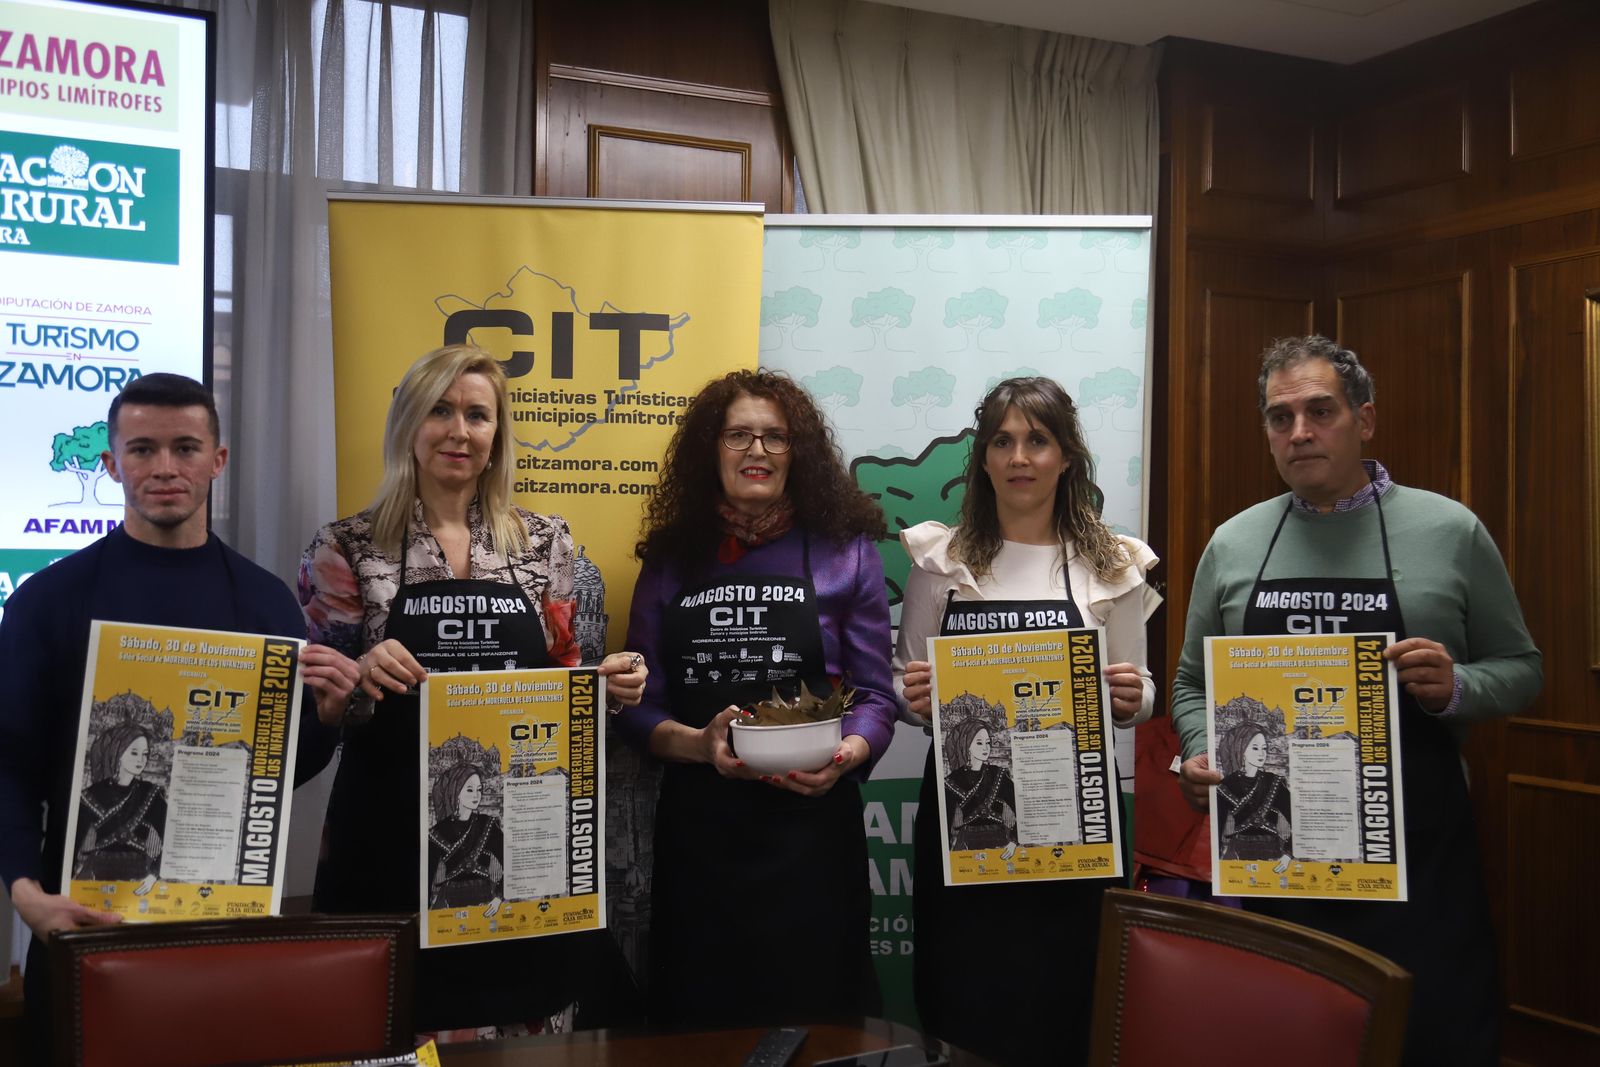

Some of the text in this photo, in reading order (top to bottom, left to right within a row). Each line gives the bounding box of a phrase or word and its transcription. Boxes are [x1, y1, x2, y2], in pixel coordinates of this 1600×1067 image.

[57, 84, 163, 113] LIMÍTROFES
[1, 188, 146, 232] RURAL
[76, 301, 93, 313] DE
[96, 303, 153, 316] ZAMORA
[444, 310, 670, 380] CIT
[66, 352, 81, 361] EN
[509, 388, 698, 407] niciativas Turísticas
[511, 409, 684, 427] unicipios limítrofe
[404, 595, 527, 615] MAGOSTO 2024
[680, 585, 805, 608] MAGOSTO 2024
[1256, 591, 1388, 611] MAGOSTO 2024
[709, 606, 768, 626] CIT
[946, 610, 1068, 630] MAGOSTO 2024
[1286, 614, 1348, 634] CIT
[437, 619, 499, 640] CIT
[119, 635, 256, 658] Sábado, 30 de Noviembre
[951, 641, 1063, 657] Sábado, 30 de Noviembre
[1229, 646, 1348, 658] Sábado, 30 de Noviembre
[189, 689, 245, 709] CIT
[446, 680, 563, 696] Sábado, 30 de Noviembre
[1014, 680, 1060, 698] CIT
[1071, 634, 1094, 751] MORERUELA DE 2024
[1294, 688, 1343, 703] CIT
[253, 644, 293, 776] MORERUELA DE 2024
[1357, 640, 1382, 763] MORERUELA DE 2024
[1085, 675, 1101, 751] LOS INFANZONES
[1372, 684, 1387, 763] LOS INFANZONES
[267, 692, 288, 777] LOS INFANZONES
[511, 723, 557, 740] CIT
[571, 674, 593, 797] MORERUELA DE 2024
[583, 718, 594, 796] LOS INFANZONES
[1079, 751, 1107, 843] MAGOSTO
[1363, 765, 1391, 861] MAGOSTO
[241, 778, 278, 884] MAGOSTO
[572, 798, 593, 894] MAGOSTO
